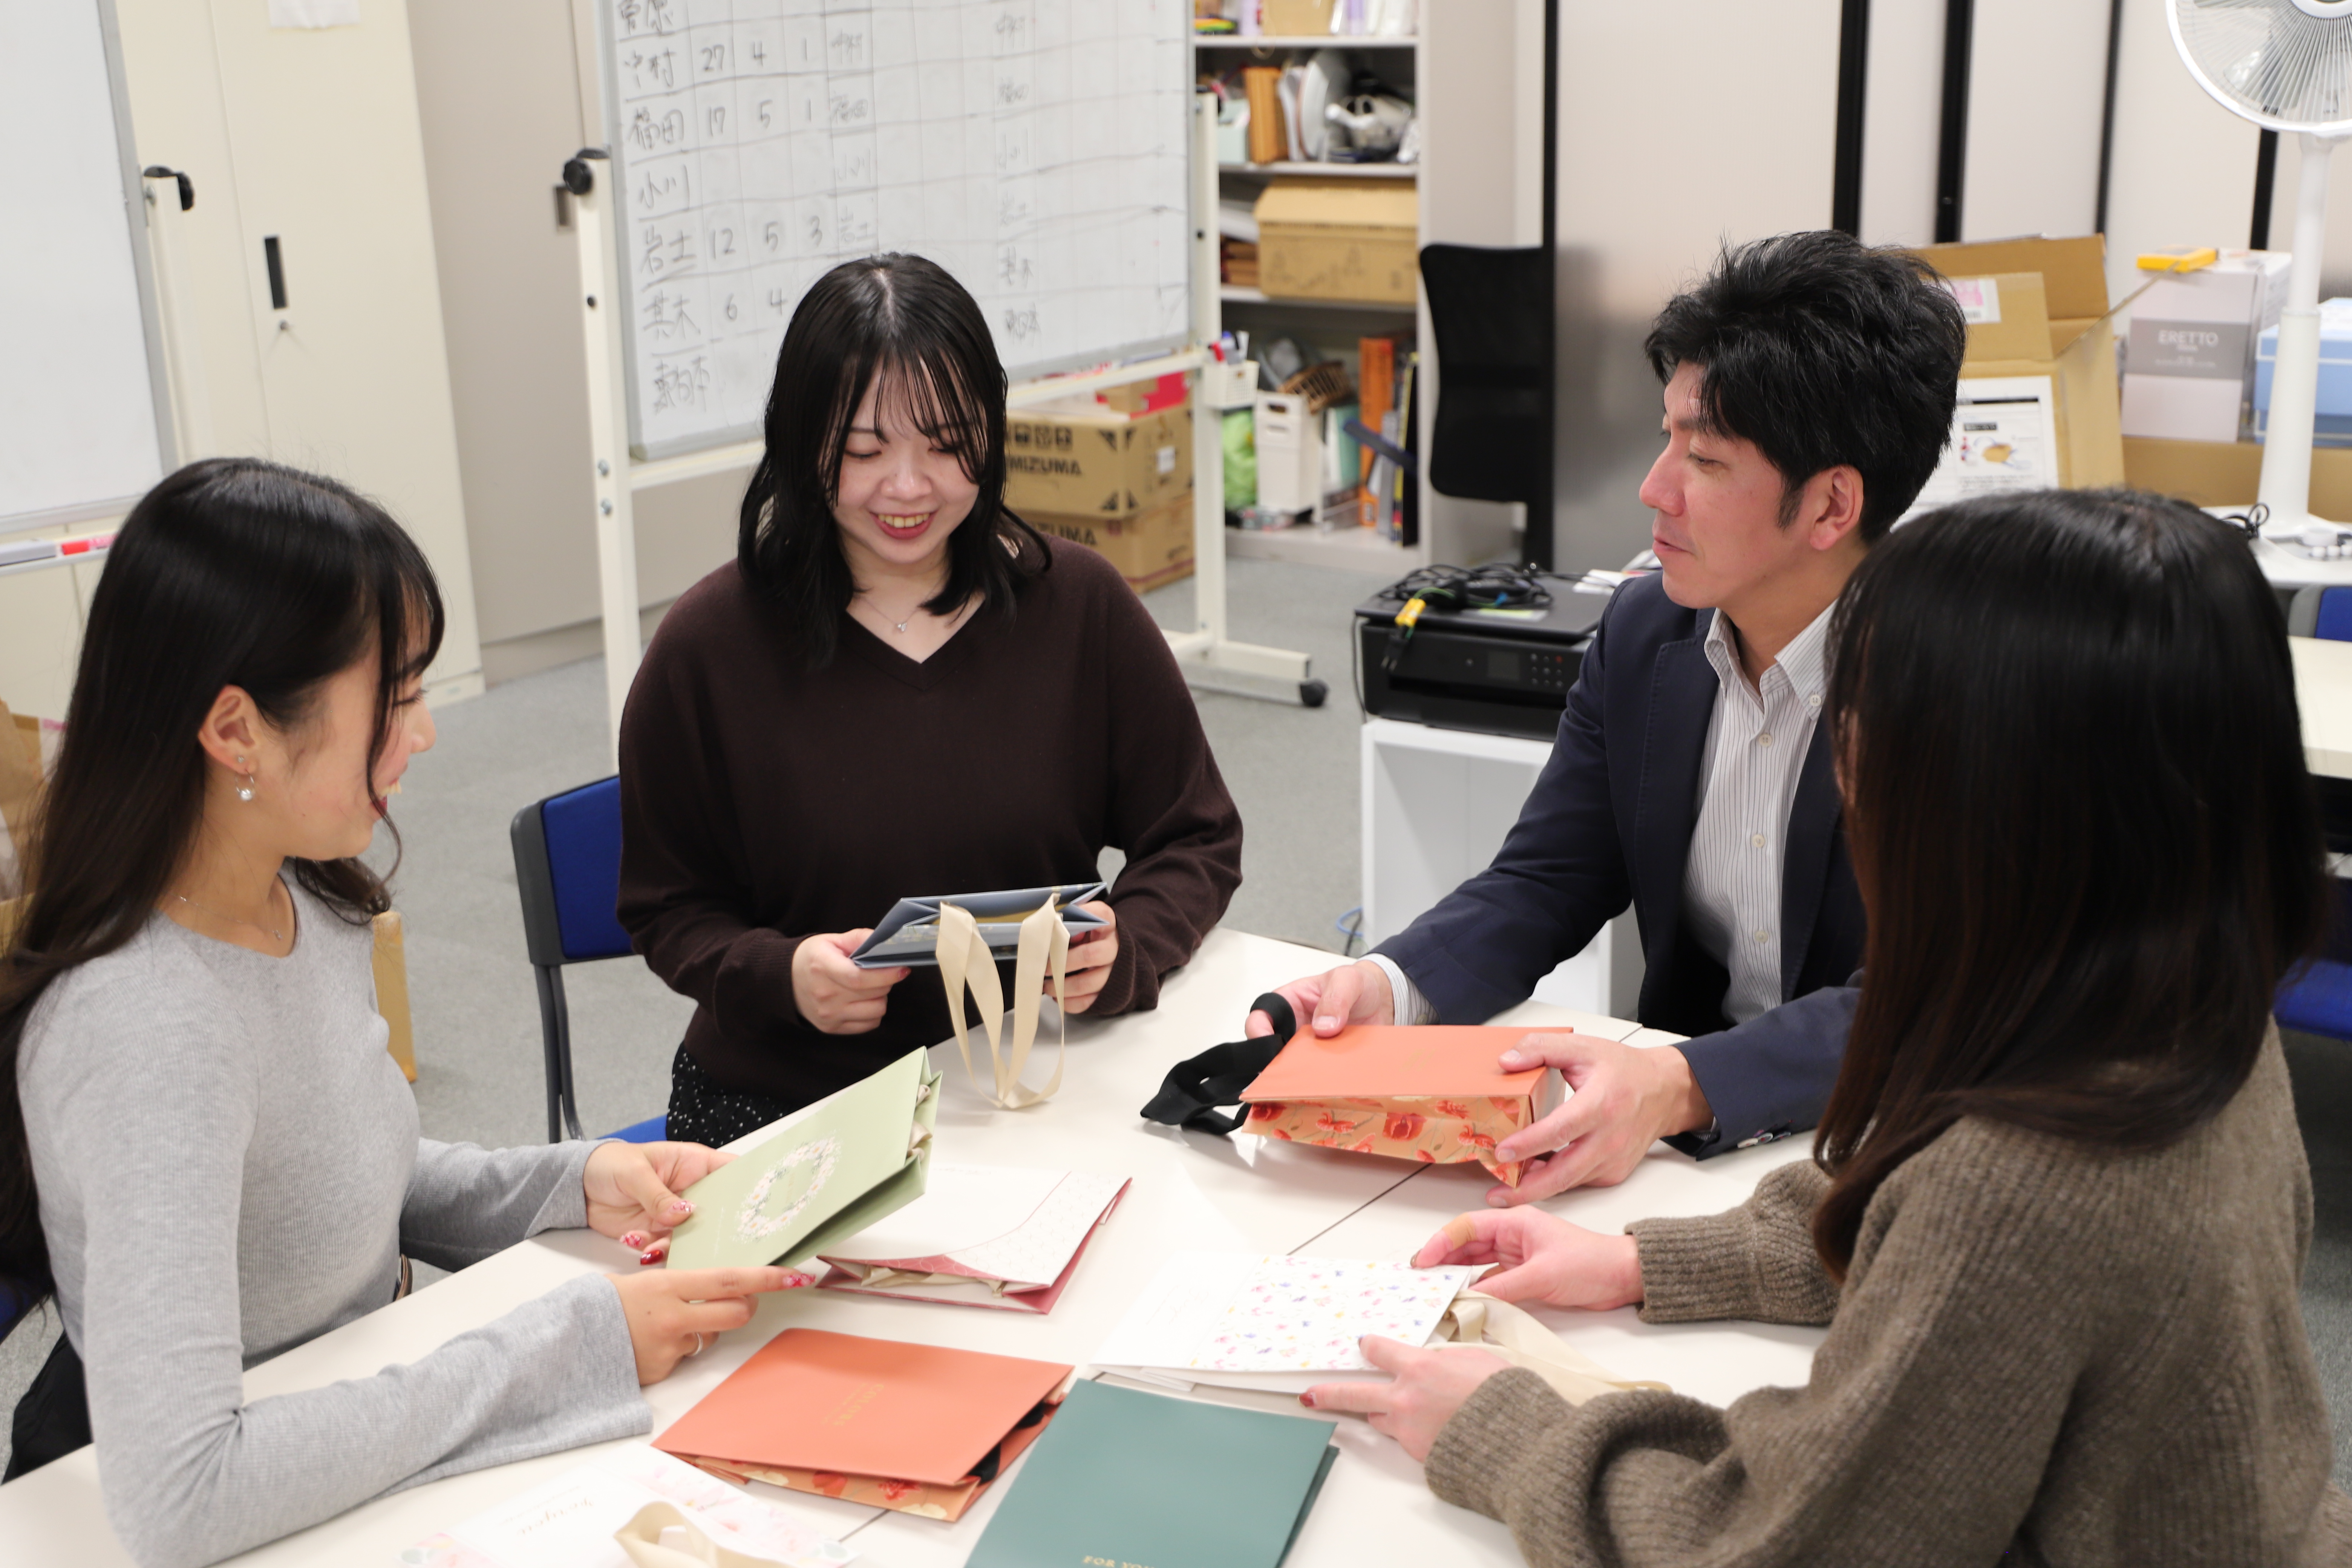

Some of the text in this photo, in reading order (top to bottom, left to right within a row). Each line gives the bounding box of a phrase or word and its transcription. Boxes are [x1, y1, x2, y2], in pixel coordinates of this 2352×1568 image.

[625, 49, 677, 88] 中村
[701, 44, 725, 72] 27
[753, 42, 766, 66] 4
[709, 106, 726, 138] 17
[759, 100, 772, 129] 5
[639, 164, 691, 210] 小川
[711, 228, 736, 260] 12
[765, 222, 779, 251] 5
[810, 216, 823, 247] 3
[726, 294, 738, 321] 6
[770, 289, 787, 315] 4
[2158, 329, 2219, 348] ERETTO
[1083, 1555, 1116, 1568] FOR
